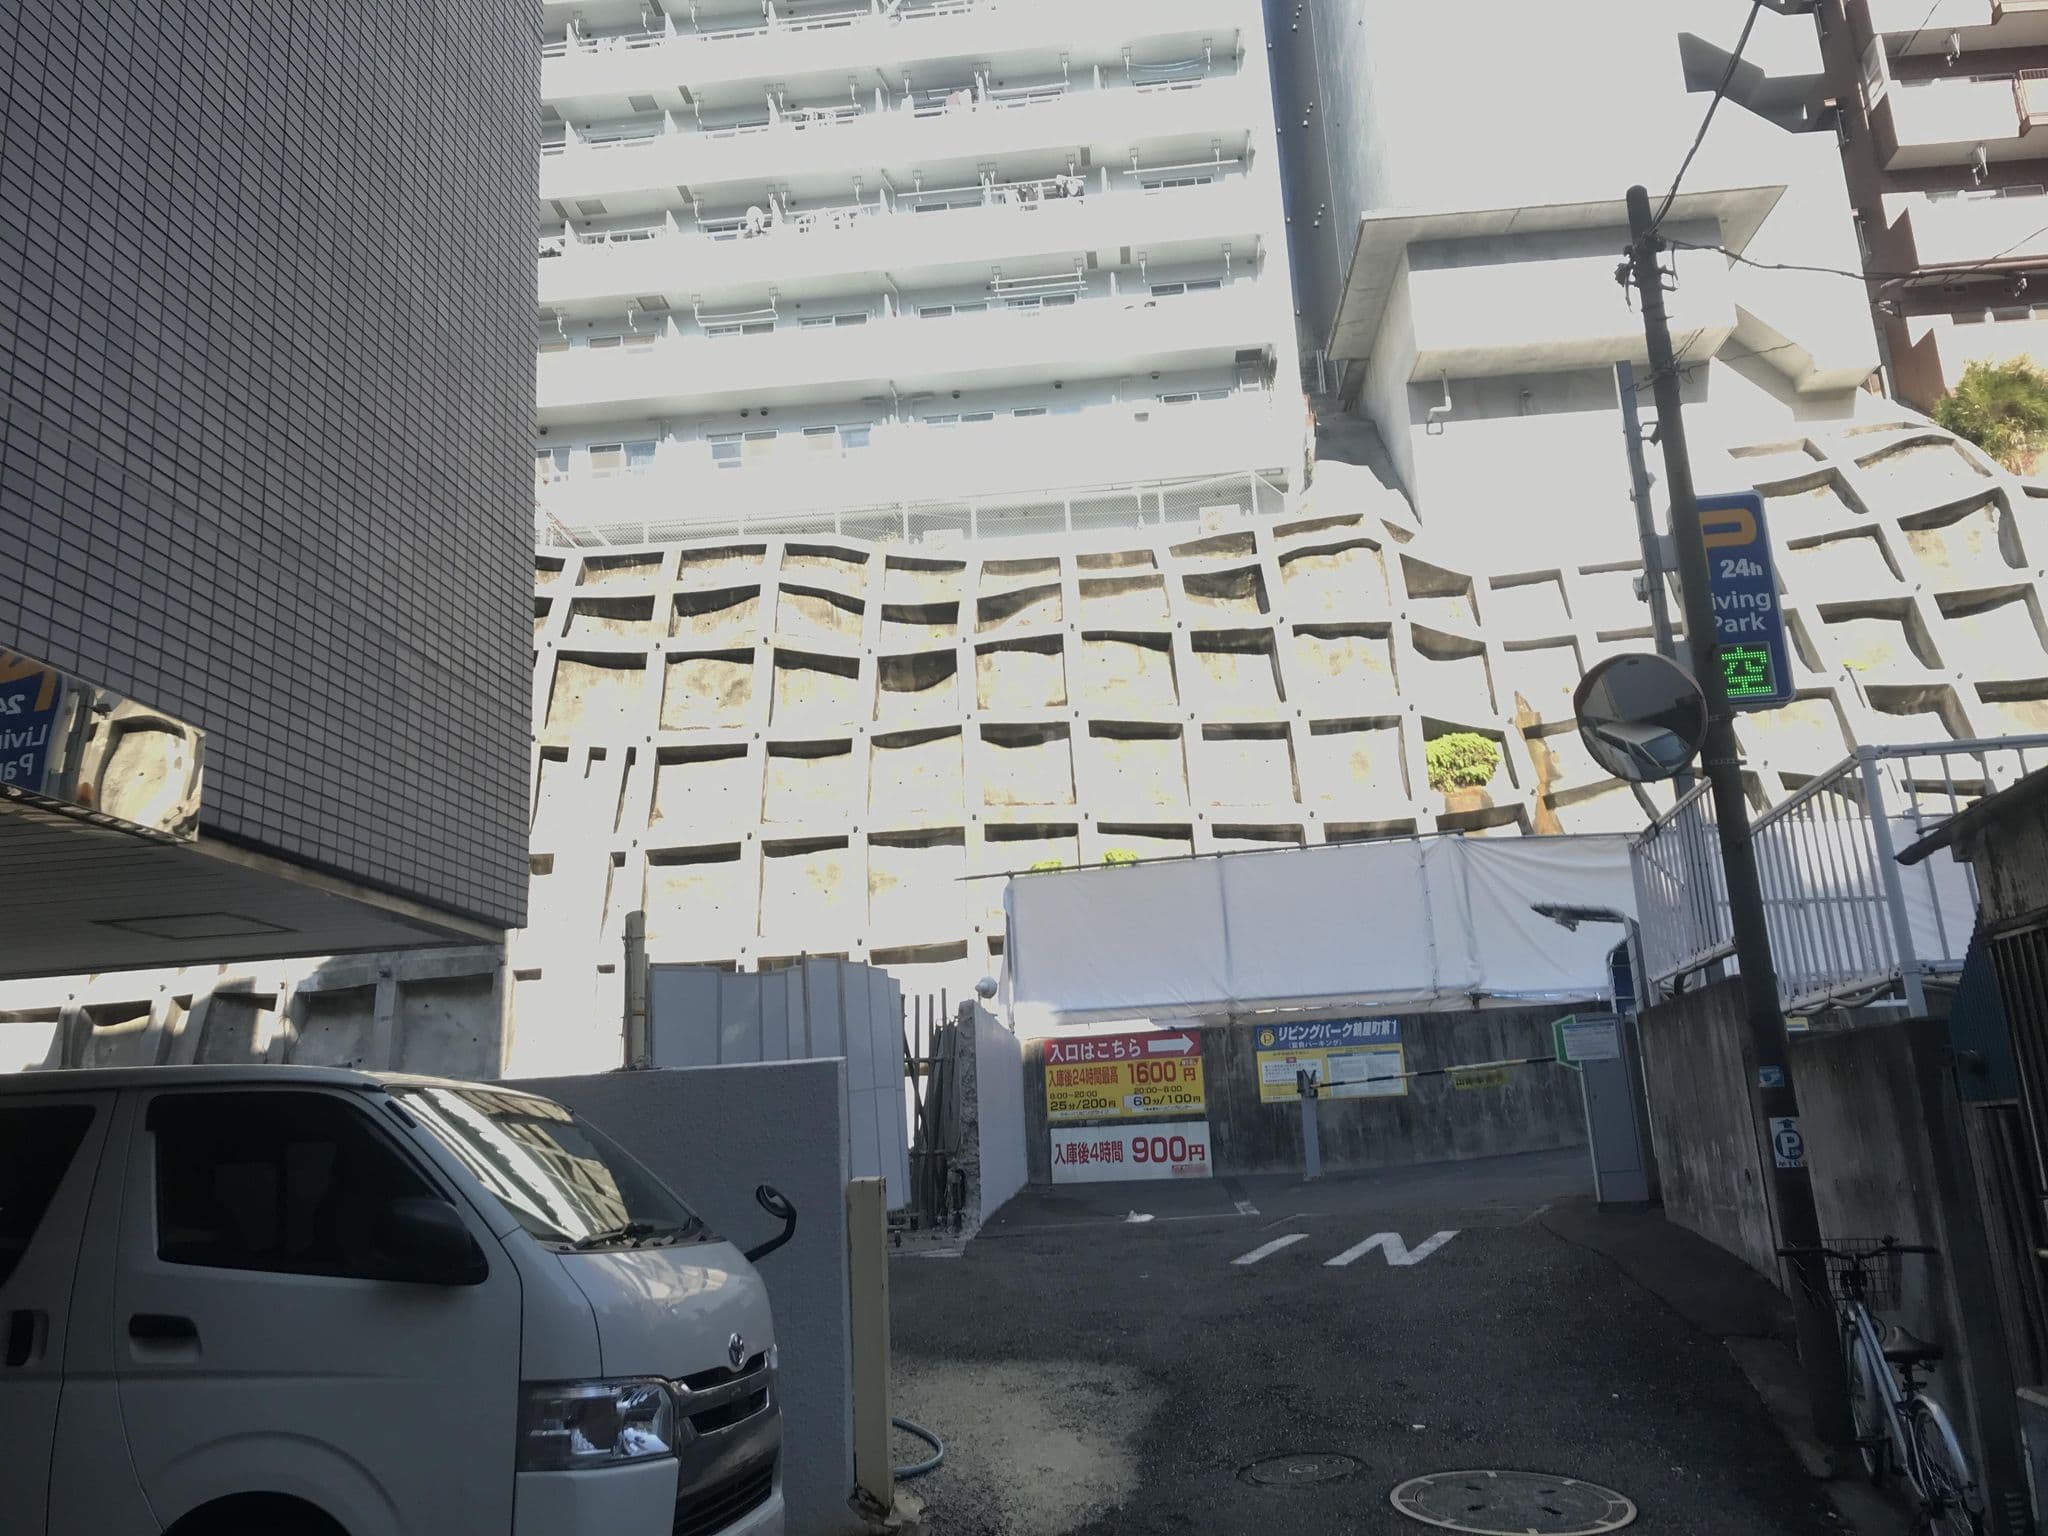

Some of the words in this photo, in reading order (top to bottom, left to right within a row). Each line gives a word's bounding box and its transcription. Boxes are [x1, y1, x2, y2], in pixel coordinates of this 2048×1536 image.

[1720, 558, 1763, 579] 24h
[1711, 590, 1772, 612] iving
[1721, 646, 1773, 696] 空
[1049, 1038, 1141, 1063] 入口はこちら
[1048, 1065, 1119, 1088] 入庫後24時間最高
[1054, 1140, 1124, 1165] 入庫後4時間
